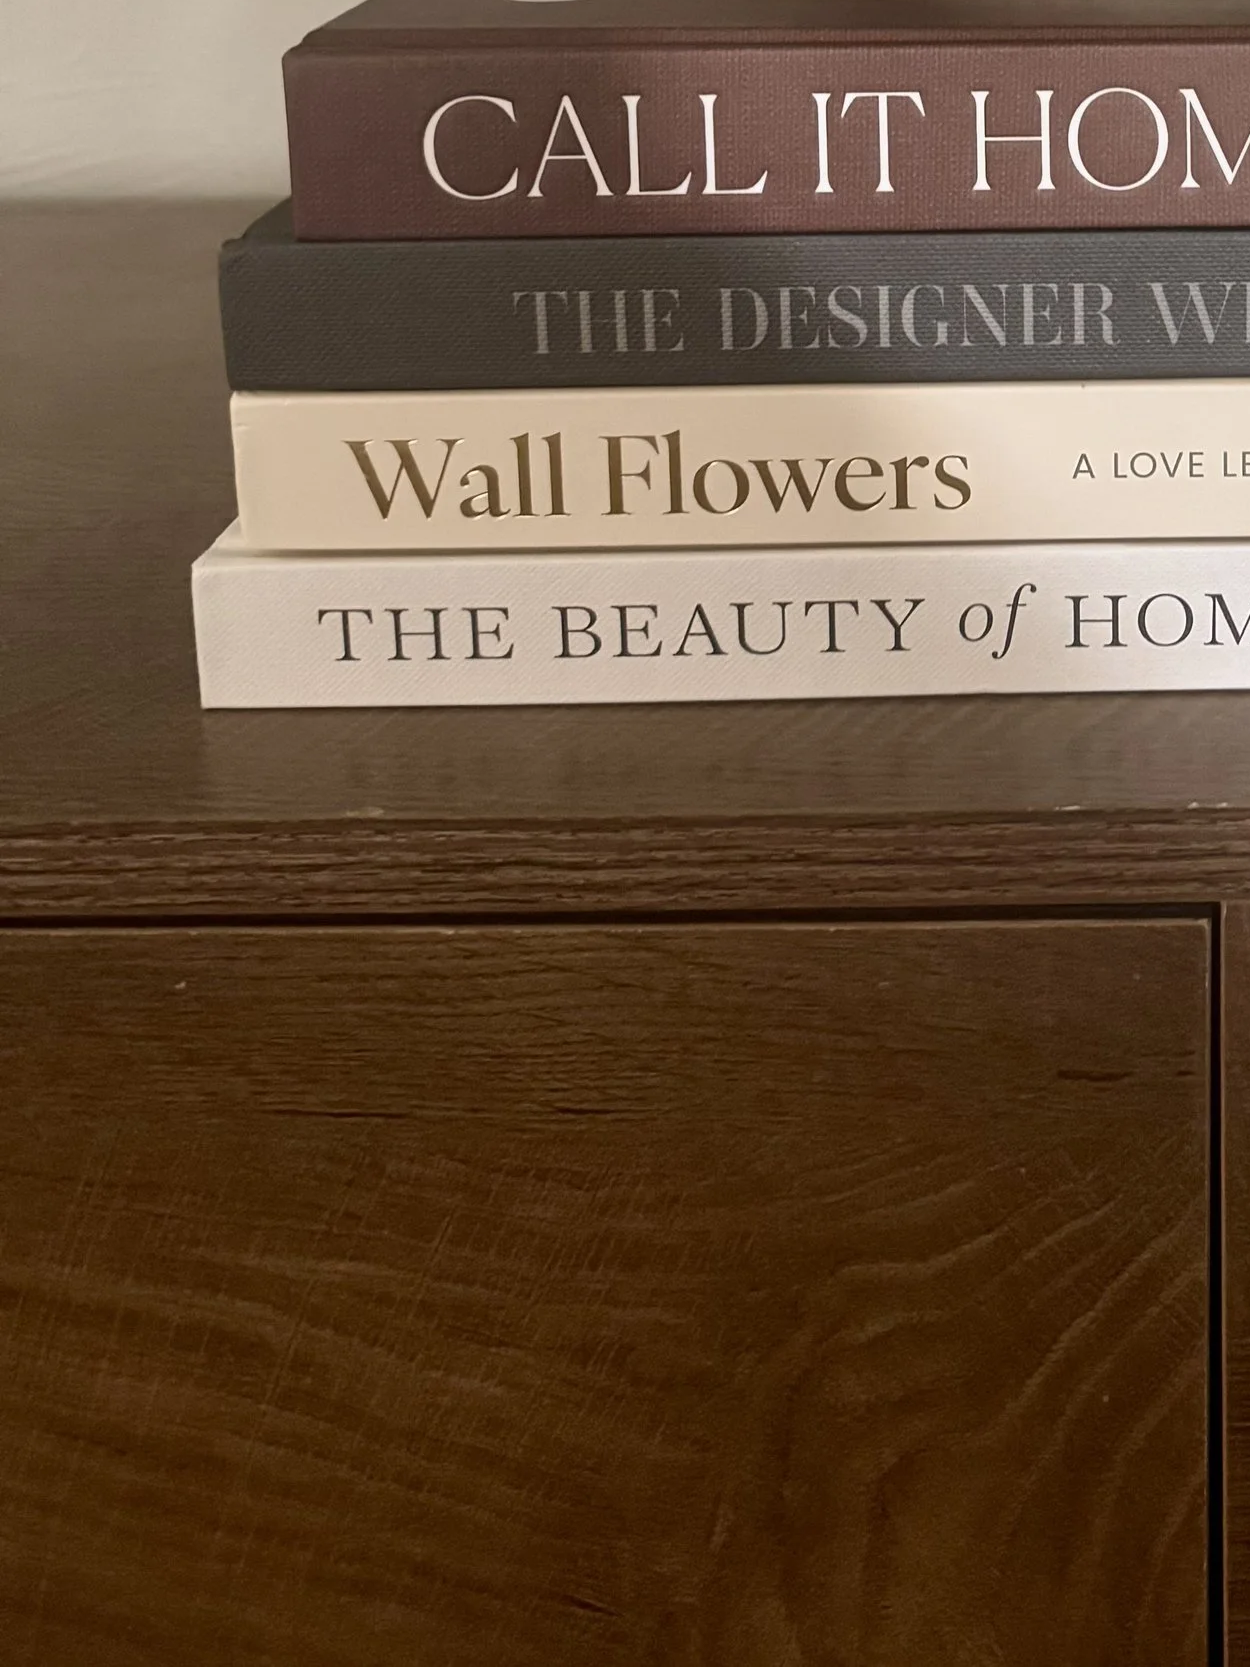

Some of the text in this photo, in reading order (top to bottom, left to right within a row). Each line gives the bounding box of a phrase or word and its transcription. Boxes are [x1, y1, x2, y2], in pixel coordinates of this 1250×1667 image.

[422, 93, 768, 201] CALL
[812, 91, 926, 194] IT
[512, 288, 683, 354] THE
[719, 282, 1114, 349] DESIGNER
[345, 430, 972, 520] Wall Flowers
[1072, 452, 1096, 480] A
[1113, 451, 1205, 479] LOVE
[317, 606, 514, 662] THE
[552, 598, 925, 659] BEAUTY
[958, 582, 1038, 660] of
